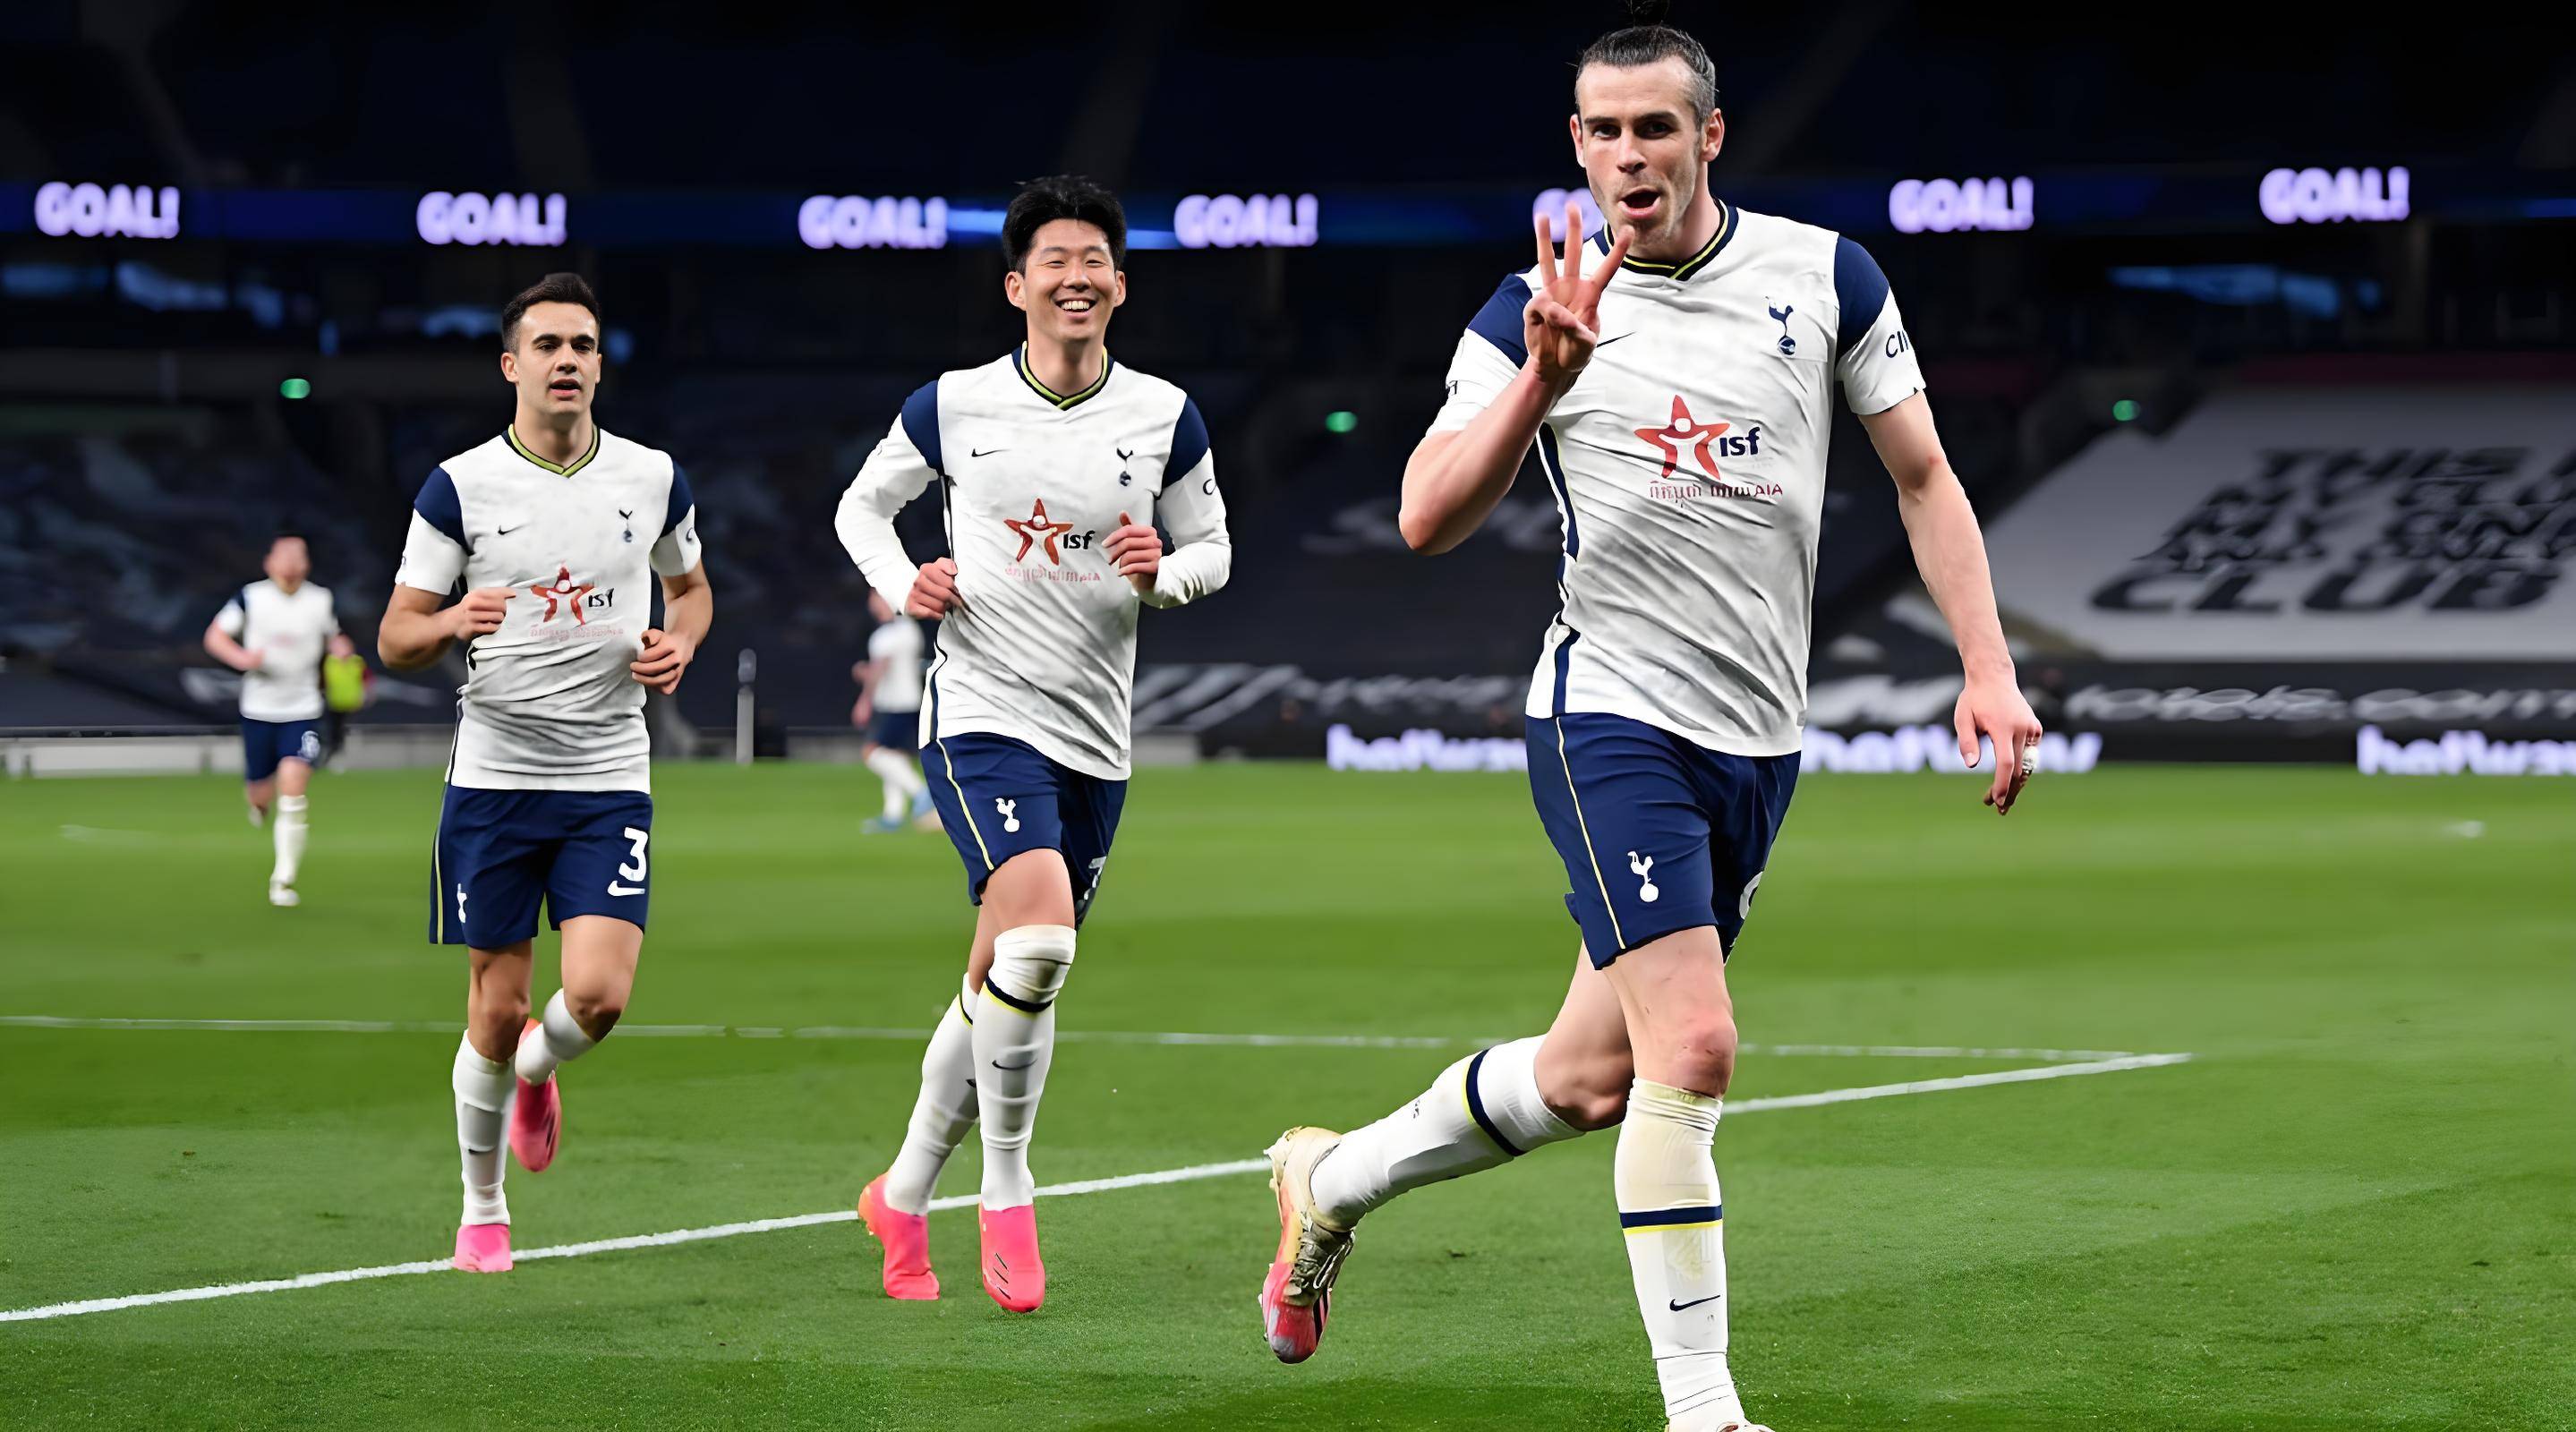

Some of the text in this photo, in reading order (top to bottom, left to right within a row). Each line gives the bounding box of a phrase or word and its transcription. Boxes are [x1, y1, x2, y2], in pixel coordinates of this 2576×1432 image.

[36, 182, 179, 239] GOAL!
[417, 192, 567, 245] GOAL!
[799, 196, 949, 249] GOAL!
[1174, 194, 1318, 247] GOAL!
[1889, 177, 2034, 233] GOAL!
[2260, 167, 2409, 224] GOAL!
[618, 826, 650, 882] 3
